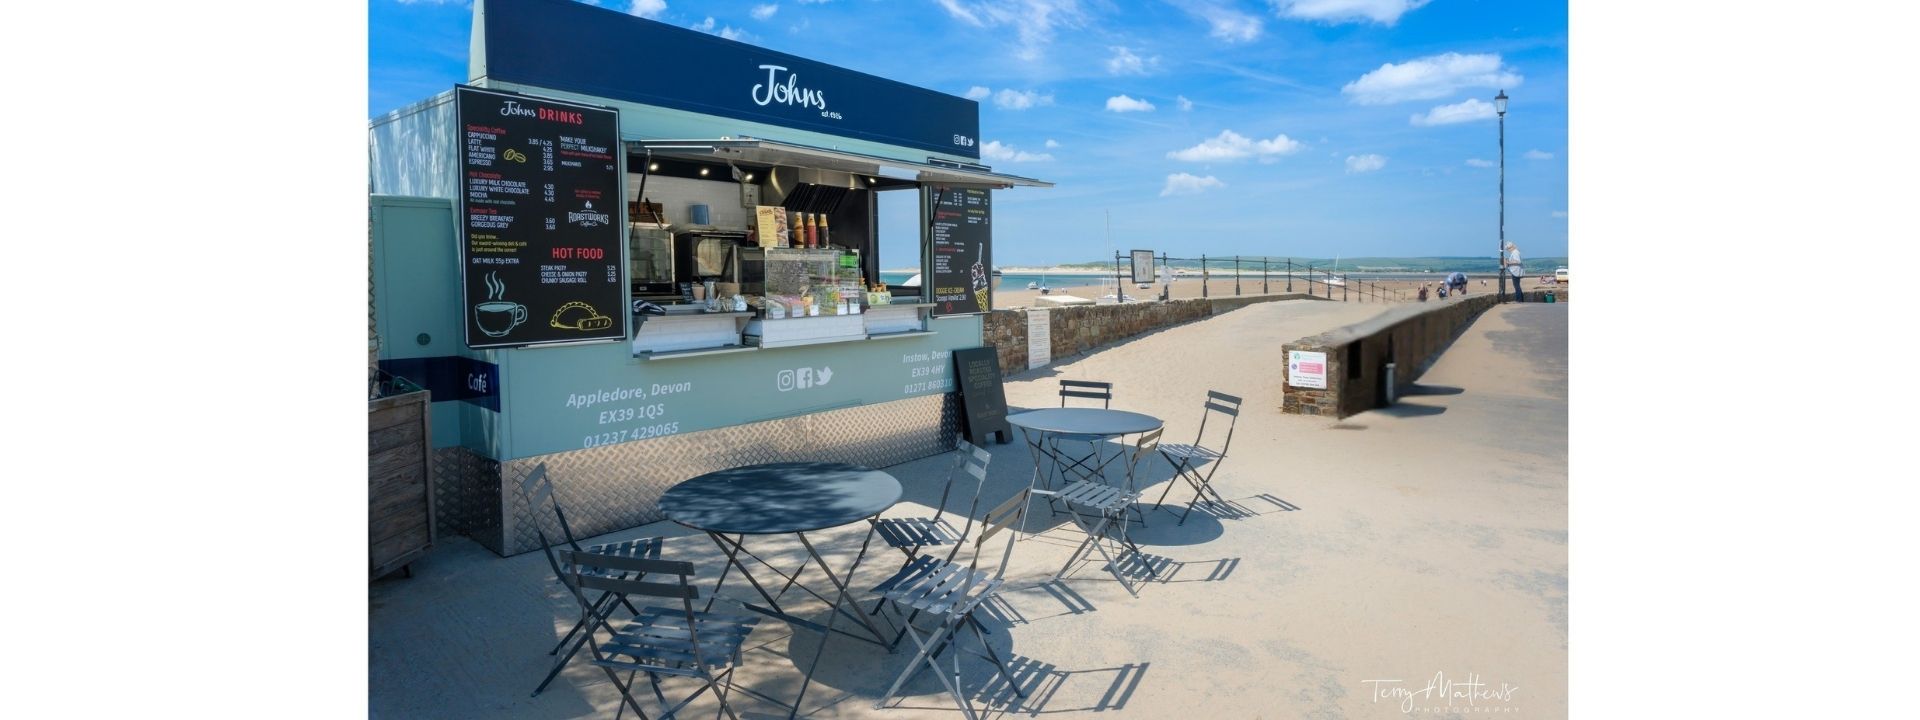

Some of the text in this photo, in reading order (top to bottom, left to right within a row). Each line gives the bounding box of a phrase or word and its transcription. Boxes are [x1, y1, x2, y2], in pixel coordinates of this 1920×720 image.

[752, 64, 826, 110] Johns
[500, 101, 583, 125] Johns DRINKS
[468, 132, 497, 140] CAPPUCCINO
[574, 137, 587, 145] YOUR
[468, 151, 496, 160] AMERICANO
[469, 158, 492, 166] ESPRESSO
[501, 180, 526, 188] CHOCOLATE
[504, 187, 529, 195] CHOCOLATE
[568, 211, 609, 225] ROASTWORKS
[552, 247, 604, 259] HOT FOOD
[903, 353, 930, 363] Instow,
[912, 365, 945, 378] EX39 4HY
[467, 373, 487, 393] Café
[904, 383, 926, 394] 01271
[566, 381, 692, 409] Appledore, Devon
[598, 403, 664, 425] EX39 1QS
[583, 422, 680, 449] 01237 429065
